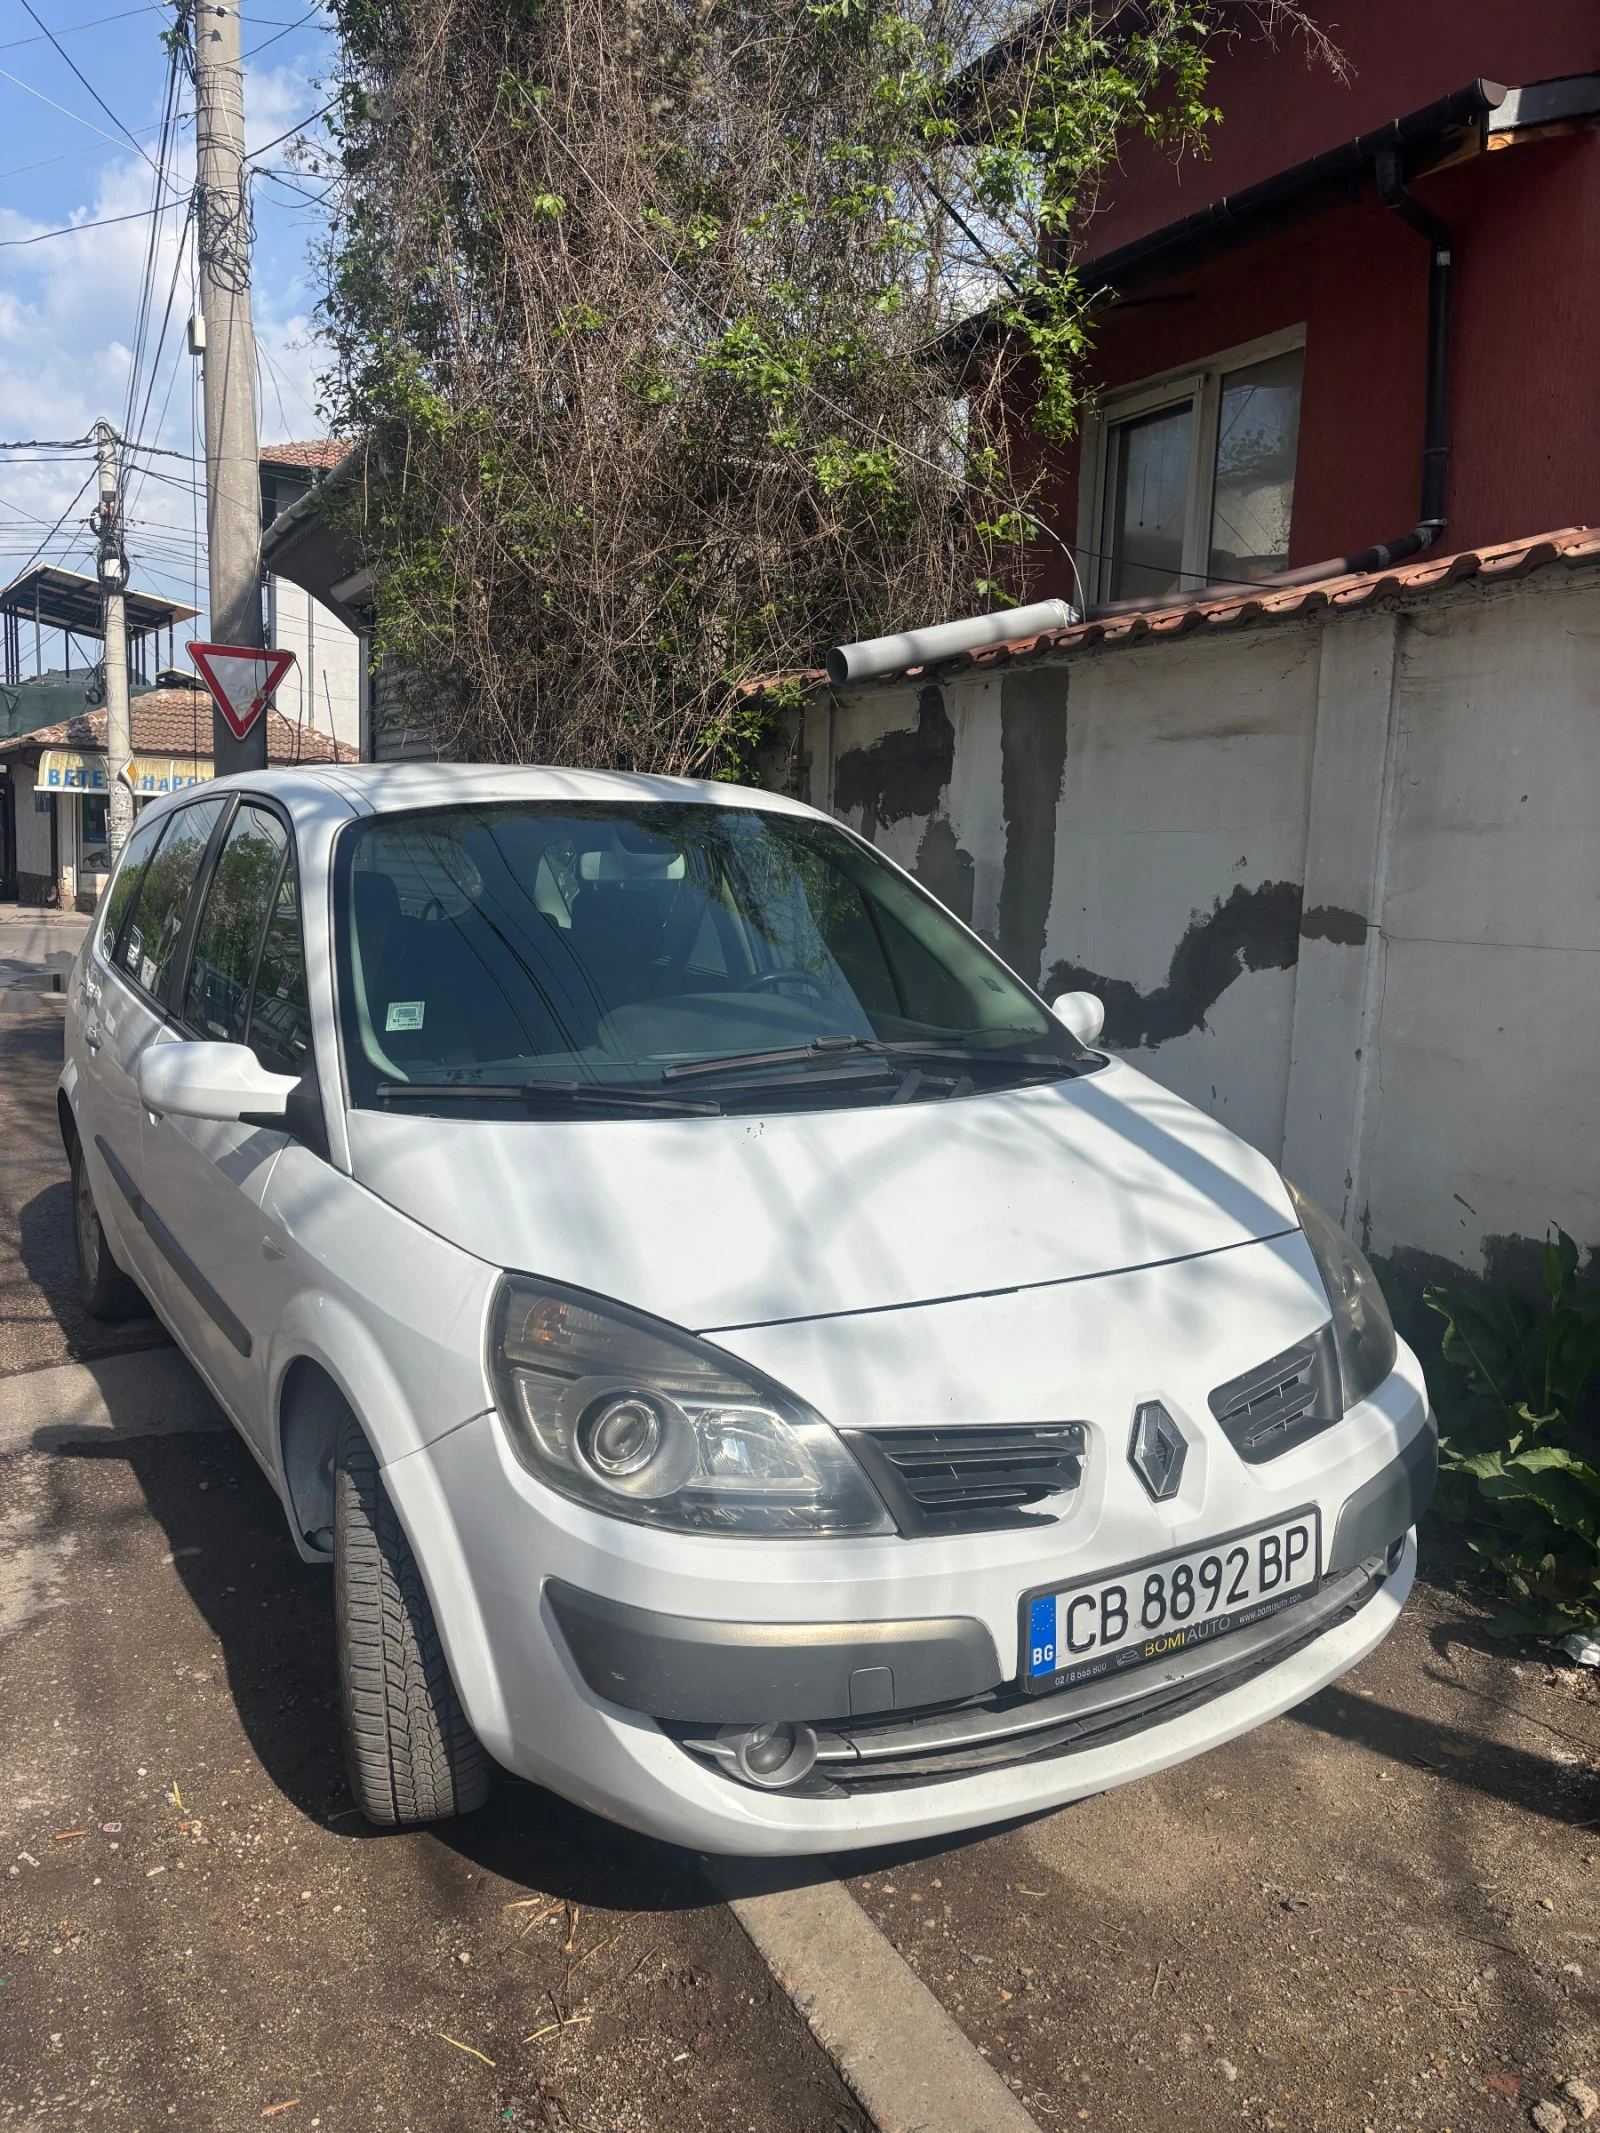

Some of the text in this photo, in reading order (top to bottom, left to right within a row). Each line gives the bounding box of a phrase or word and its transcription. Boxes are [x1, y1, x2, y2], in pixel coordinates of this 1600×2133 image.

[48, 769, 213, 792] ВЕТЕНАРЕ
[1140, 1547, 1249, 1629] 8892
[1032, 1645, 1054, 1666] BG
